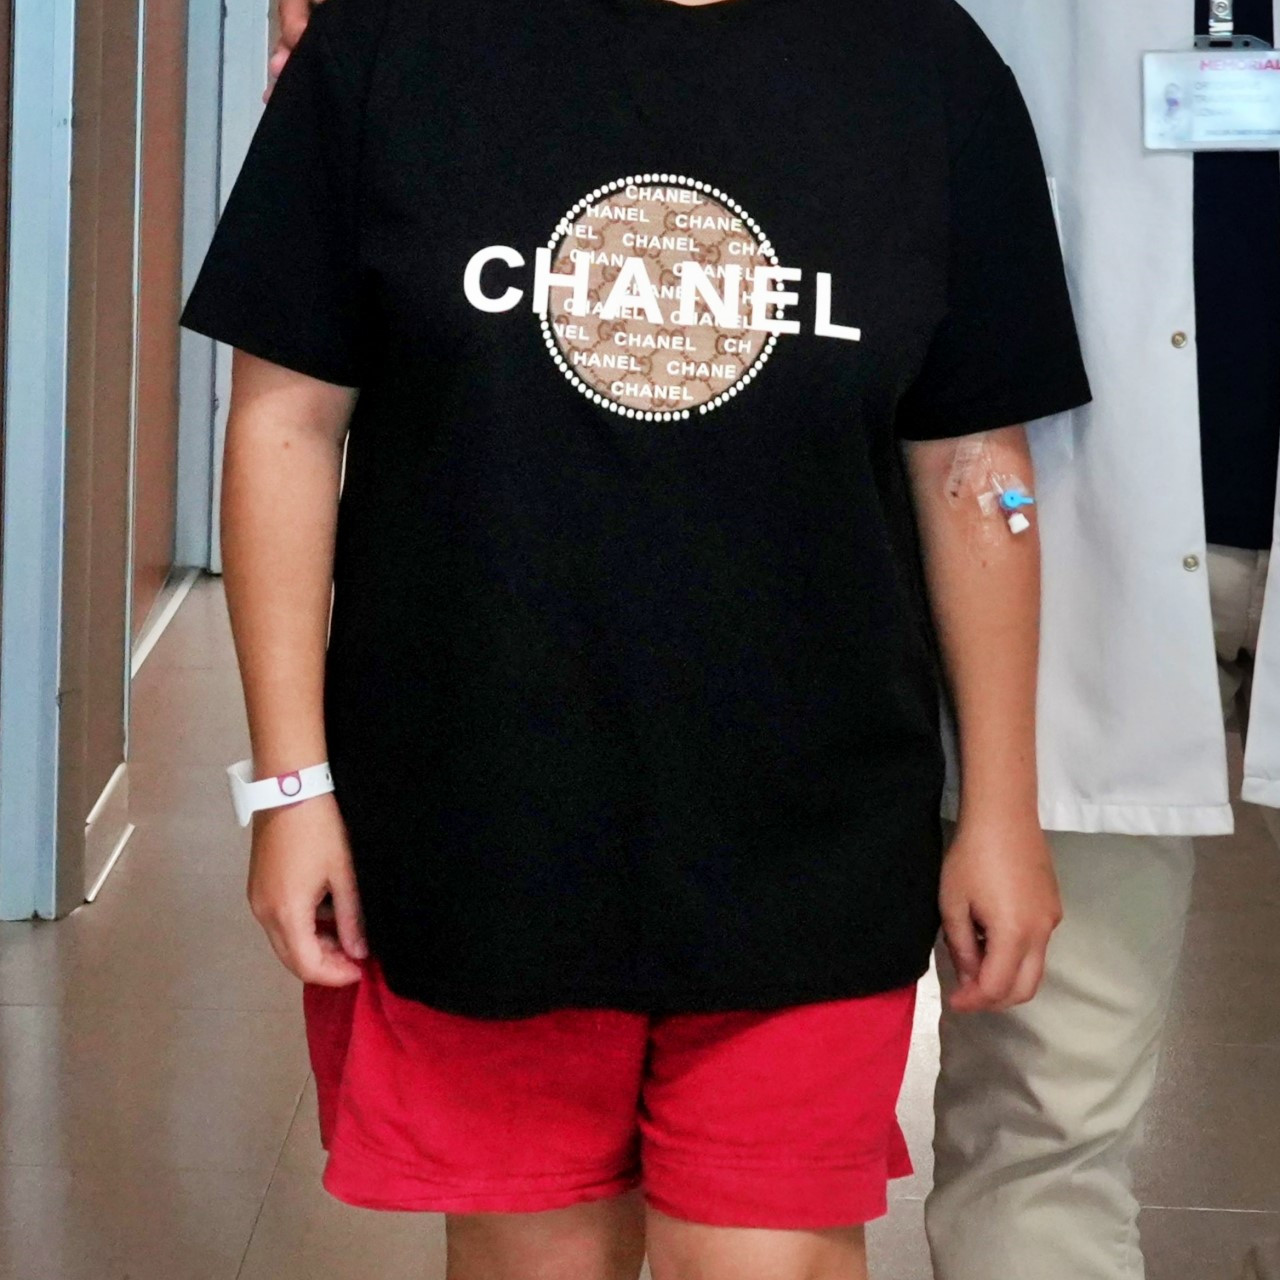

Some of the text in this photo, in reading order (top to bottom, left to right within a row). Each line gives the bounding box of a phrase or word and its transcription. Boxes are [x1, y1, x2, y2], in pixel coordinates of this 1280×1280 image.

[625, 184, 703, 205] CHANEL
[586, 203, 743, 233] HANEL CHANE
[622, 232, 700, 253] CHANEL
[463, 244, 862, 342] CHANEL
[614, 331, 697, 352] CHANEL
[724, 338, 752, 354] CH
[573, 351, 737, 380] HANEL CHANE
[610, 380, 694, 402] CHANEL
